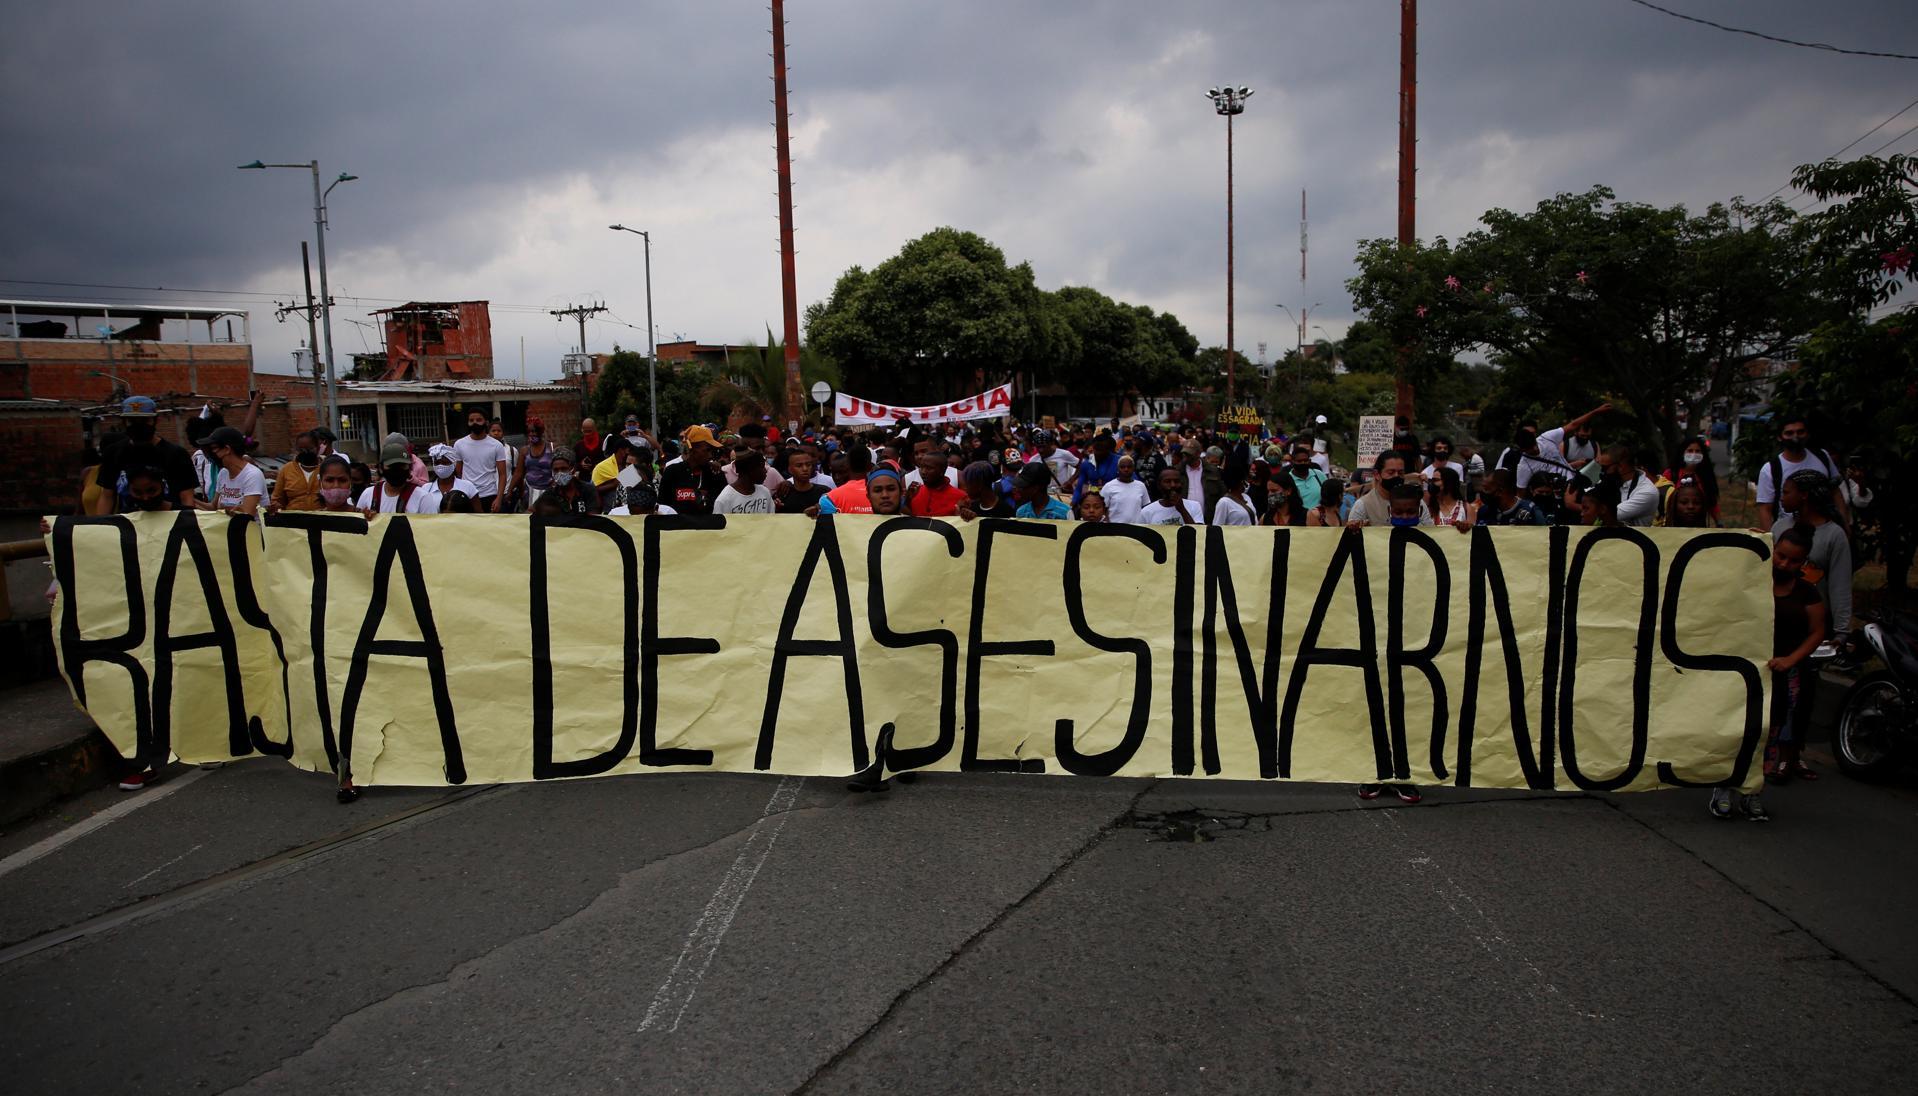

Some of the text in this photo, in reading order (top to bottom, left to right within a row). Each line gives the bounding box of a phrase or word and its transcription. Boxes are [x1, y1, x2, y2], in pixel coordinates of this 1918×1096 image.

[840, 387, 1011, 420] JUSTICIA
[1222, 405, 1256, 416] LA VIDA
[53, 510, 1771, 792] BASTA DE ASESINARNOS
